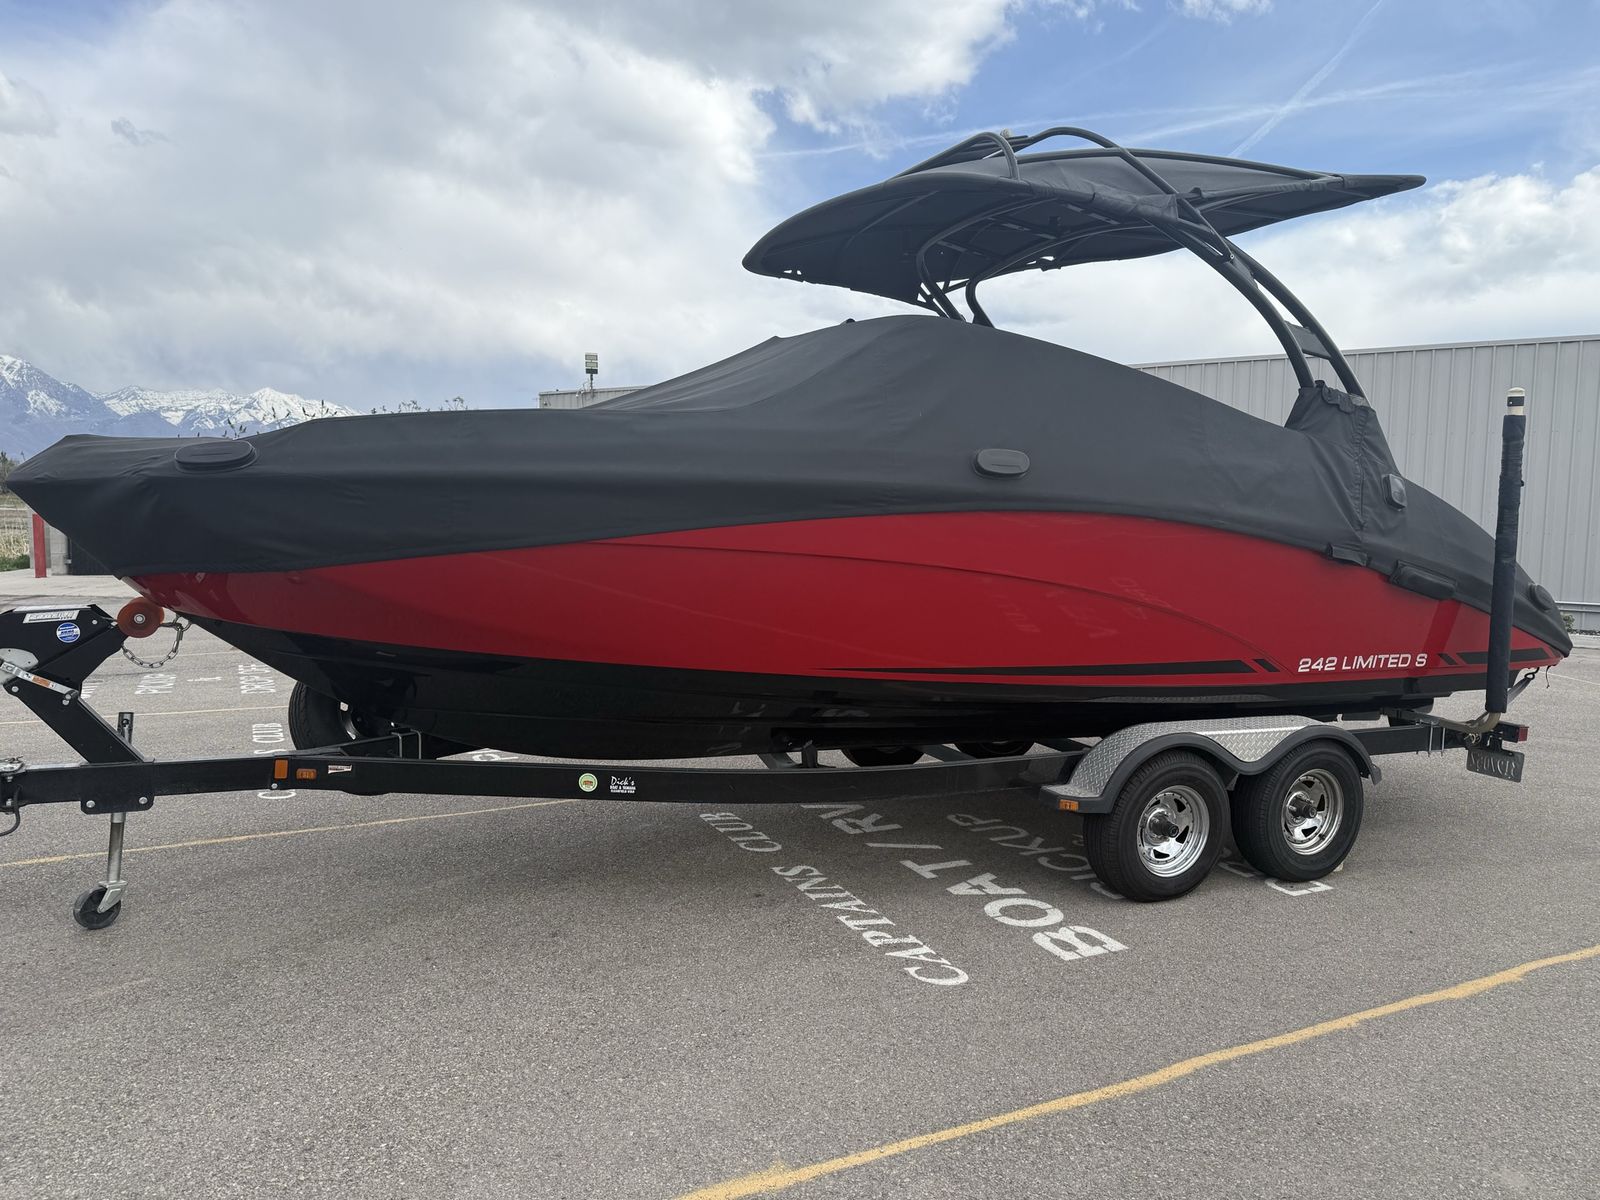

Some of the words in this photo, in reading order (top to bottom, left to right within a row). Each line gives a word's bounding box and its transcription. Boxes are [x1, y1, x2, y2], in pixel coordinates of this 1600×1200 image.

[1298, 656, 1338, 673] 242
[1341, 653, 1412, 670] LIMITED
[1415, 653, 1428, 668] S
[252, 722, 285, 743] CLUB
[610, 776, 635, 786] Dick's
[700, 811, 783, 853] CLUB
[801, 804, 903, 835] RV
[772, 865, 969, 986] CAPTAINS
[900, 859, 1128, 961] BOAT
